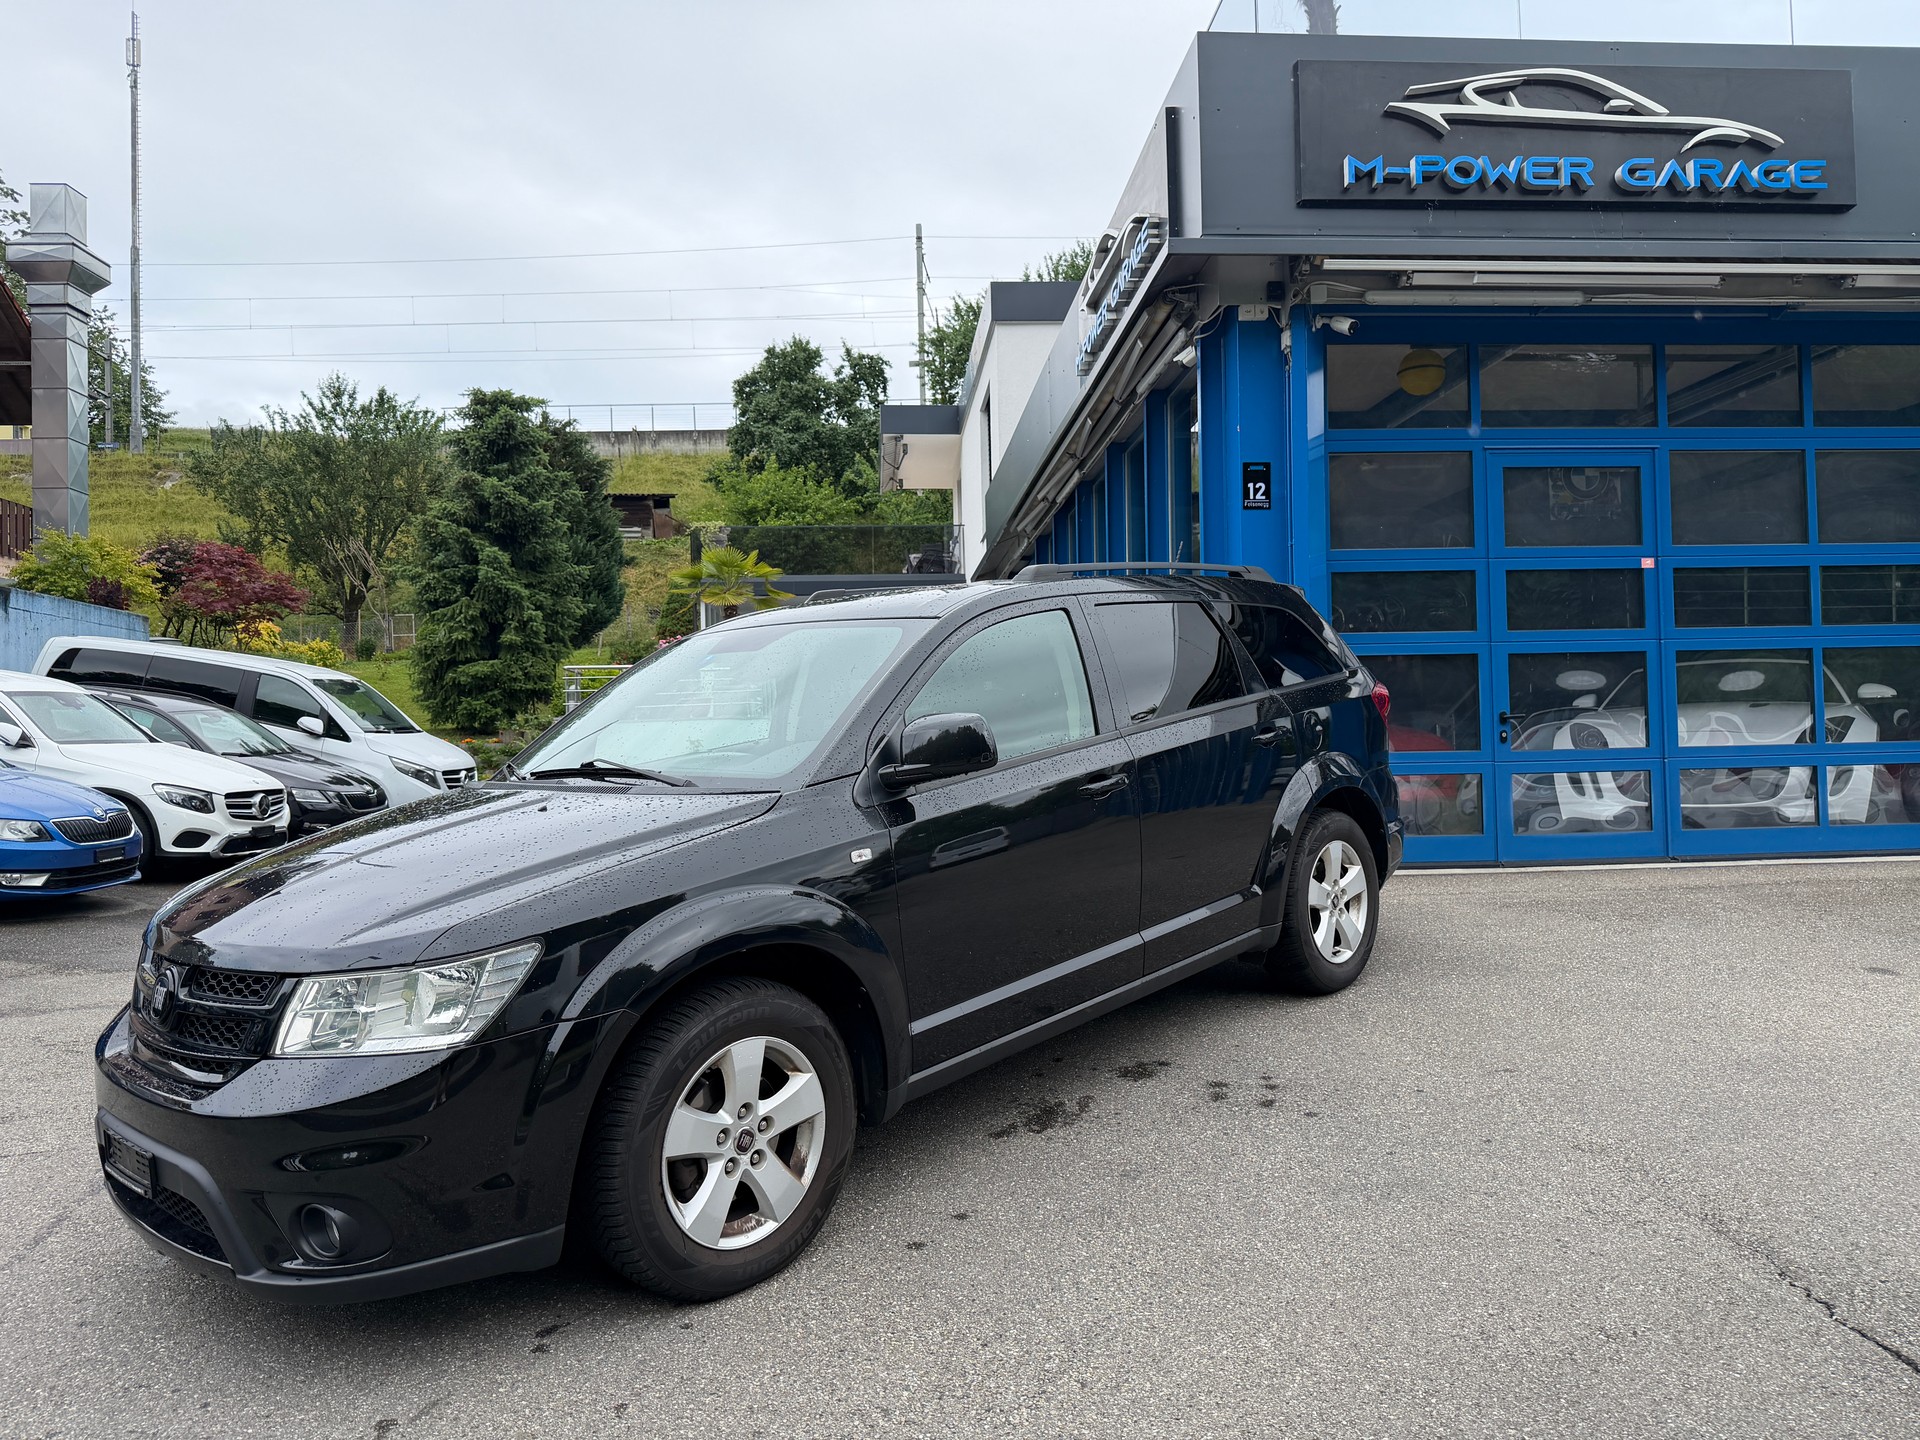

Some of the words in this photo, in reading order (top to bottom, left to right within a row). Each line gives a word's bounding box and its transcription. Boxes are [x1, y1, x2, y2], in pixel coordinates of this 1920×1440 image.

[1344, 154, 1595, 188] M-POWER
[1616, 156, 1829, 191] GARAGE
[1110, 217, 1149, 308] GARAGE
[1247, 482, 1266, 500] 12
